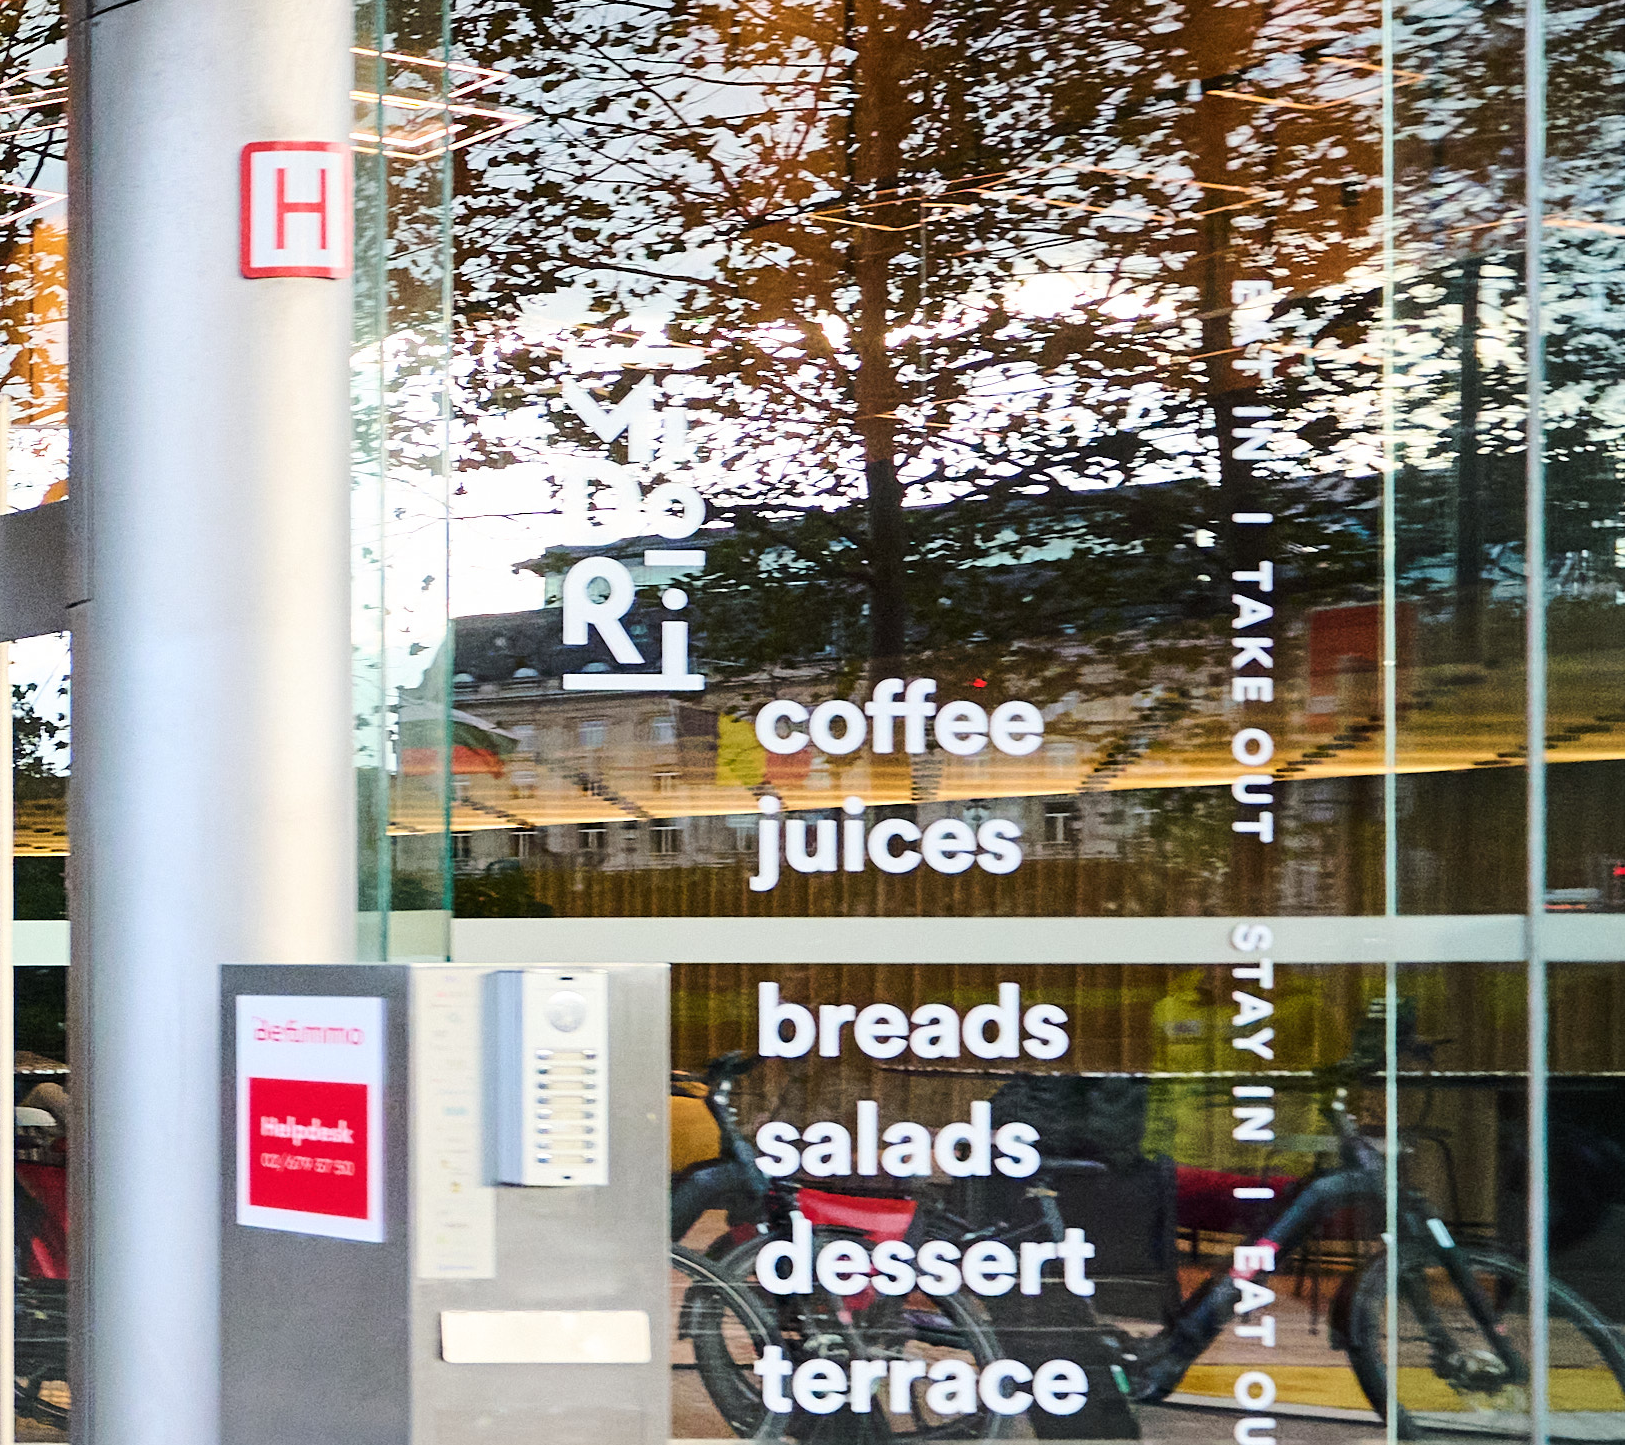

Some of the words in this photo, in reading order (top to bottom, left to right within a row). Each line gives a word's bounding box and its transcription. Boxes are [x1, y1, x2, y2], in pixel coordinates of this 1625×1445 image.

[275, 167, 328, 250] H
[1232, 406, 1273, 460] IN
[1232, 561, 1274, 703] TAKE
[755, 677, 1045, 756] coffee
[1232, 727, 1274, 844] OUT
[749, 796, 1023, 893] juices
[758, 982, 1071, 1060] breads
[1231, 923, 1275, 1062] STAY
[260, 1115, 355, 1147] Helpdesk
[756, 1101, 1041, 1178] salads
[1233, 1085, 1275, 1144] IN
[756, 1211, 1096, 1297] dessert
[1233, 1247, 1276, 1349] EAT
[754, 1345, 1089, 1416] terrace
